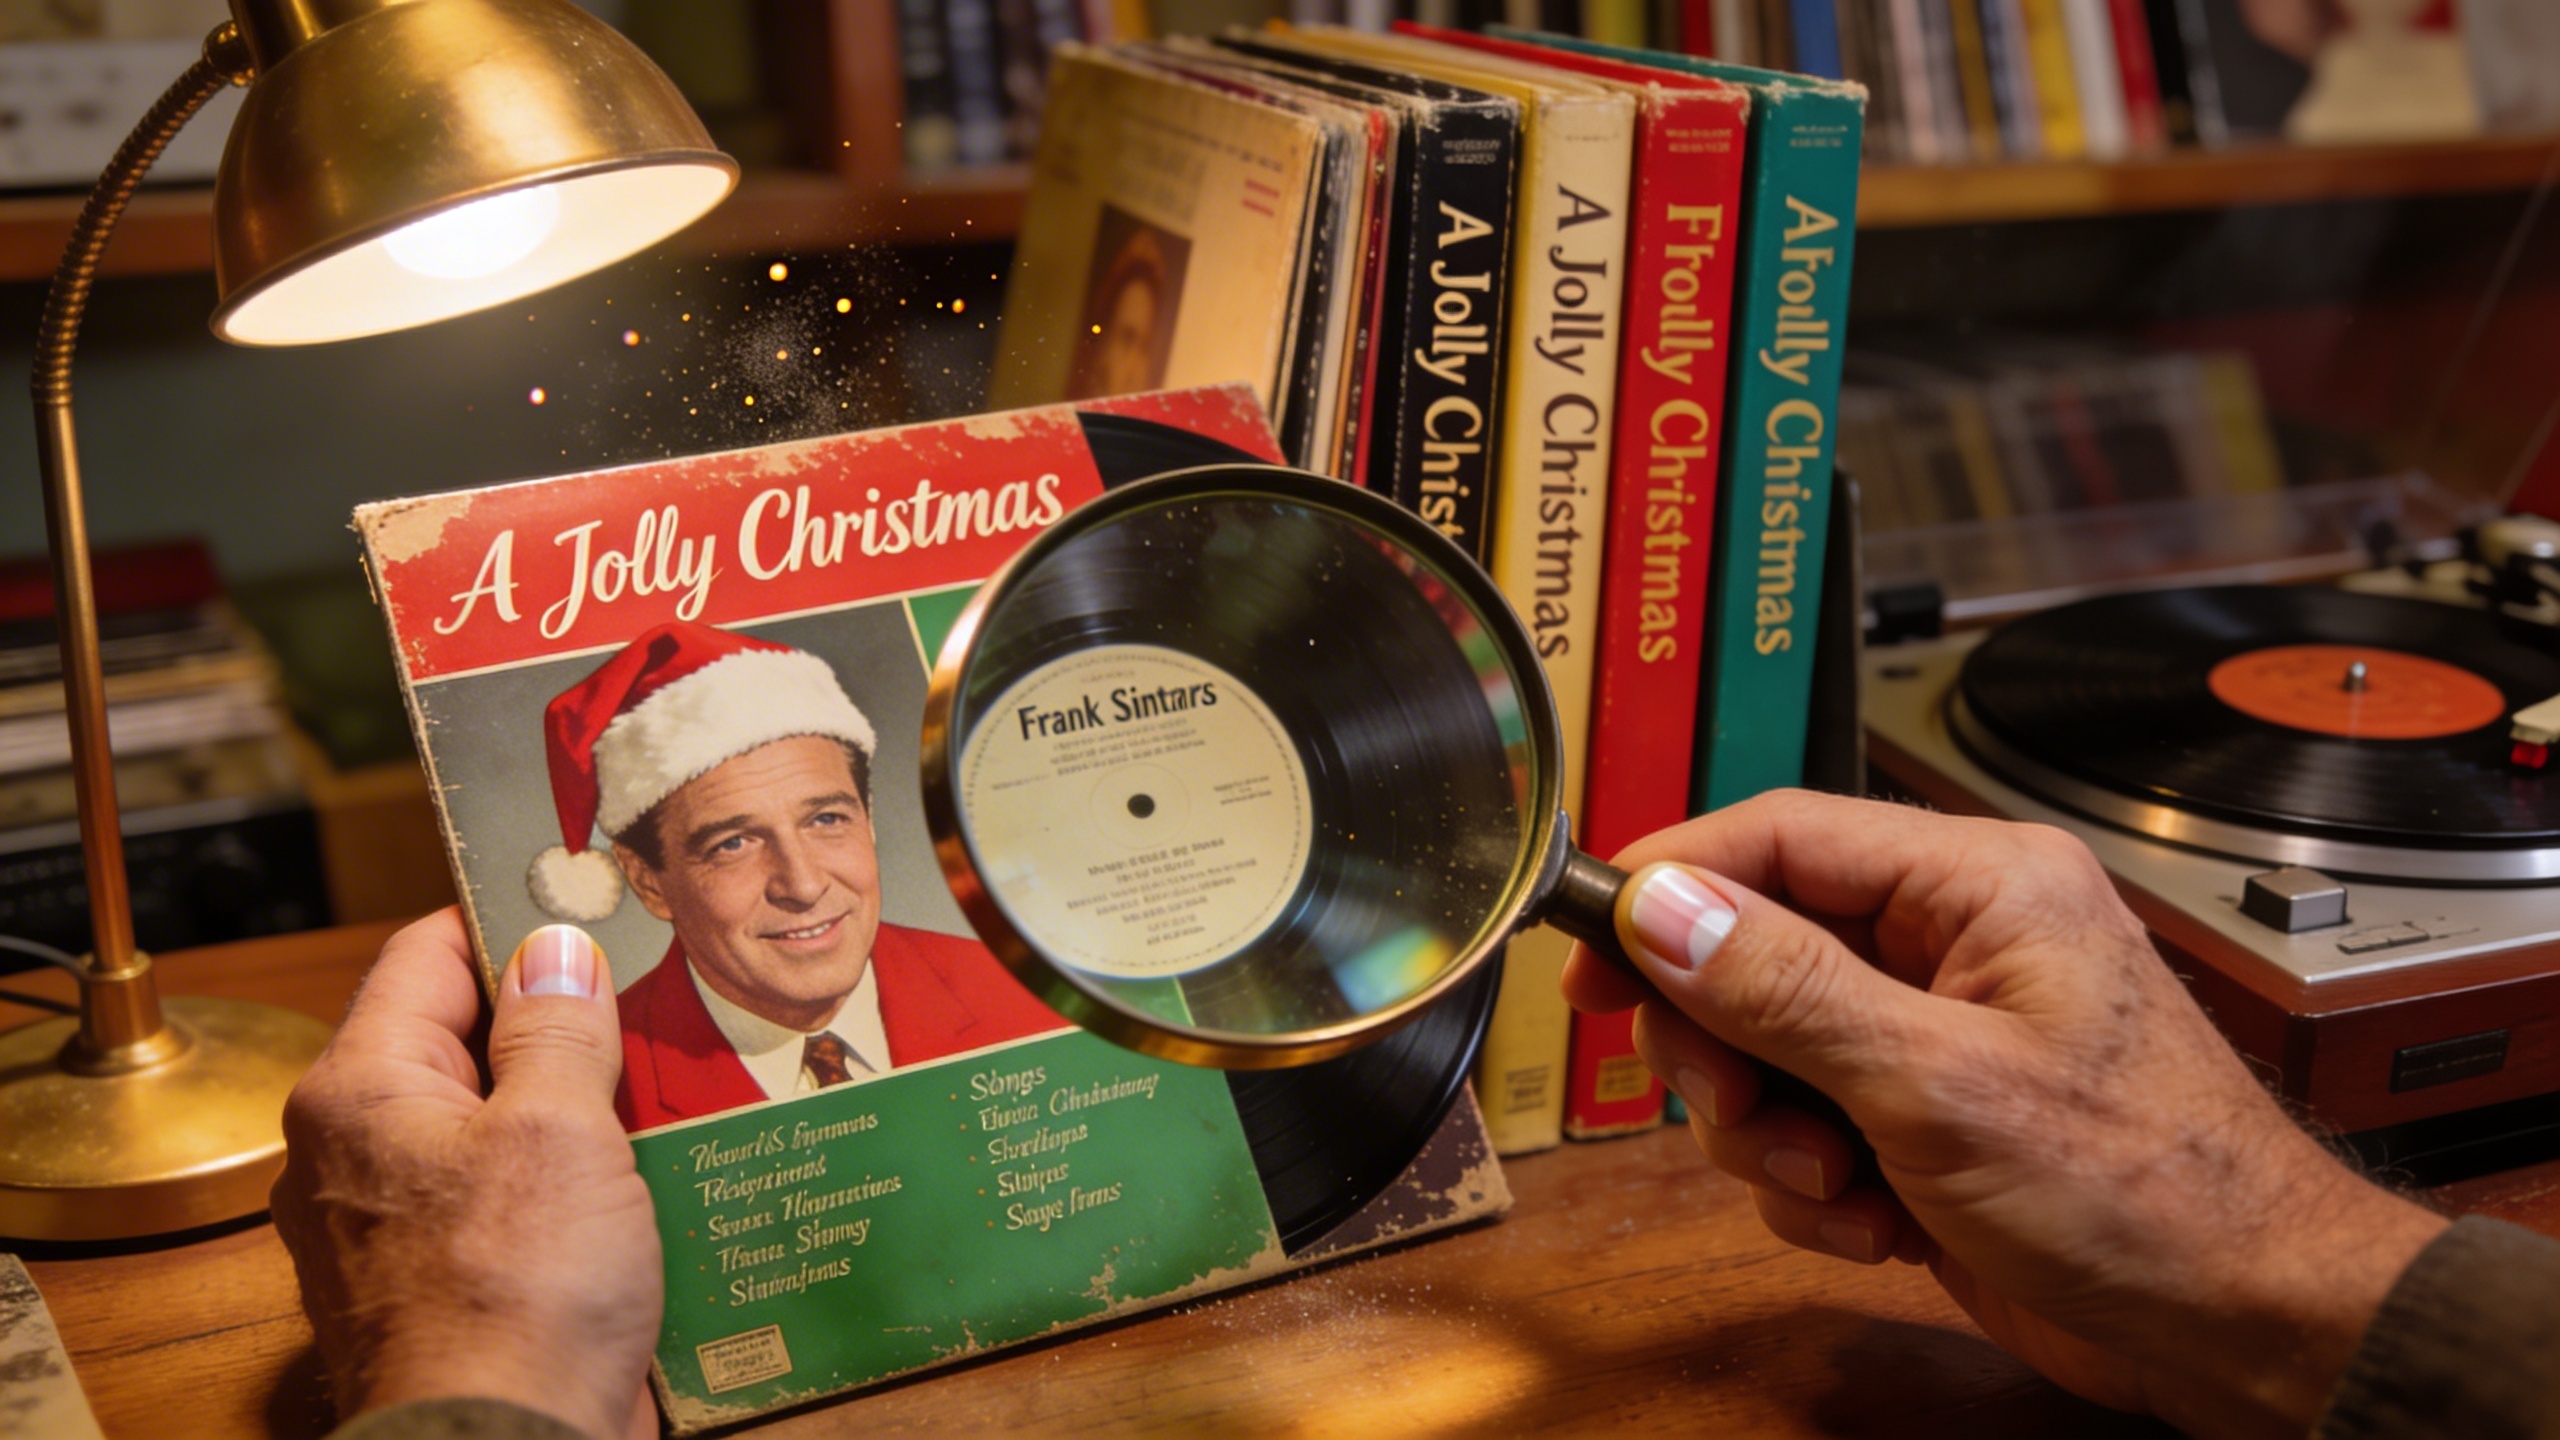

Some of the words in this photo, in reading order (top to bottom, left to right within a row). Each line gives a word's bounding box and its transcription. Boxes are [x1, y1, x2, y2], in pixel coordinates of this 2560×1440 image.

[1438, 200, 1494, 249] A
[1557, 183, 1611, 232] A
[1414, 260, 1491, 386] Jolly
[1534, 245, 1607, 376] Jolly
[433, 529, 522, 635] A
[539, 505, 723, 639] Jolly
[738, 474, 1065, 581] Christmas
[1534, 393, 1598, 661] Christmas
[1638, 399, 1710, 664] Christmas
[1018, 695, 1105, 741] Frank
